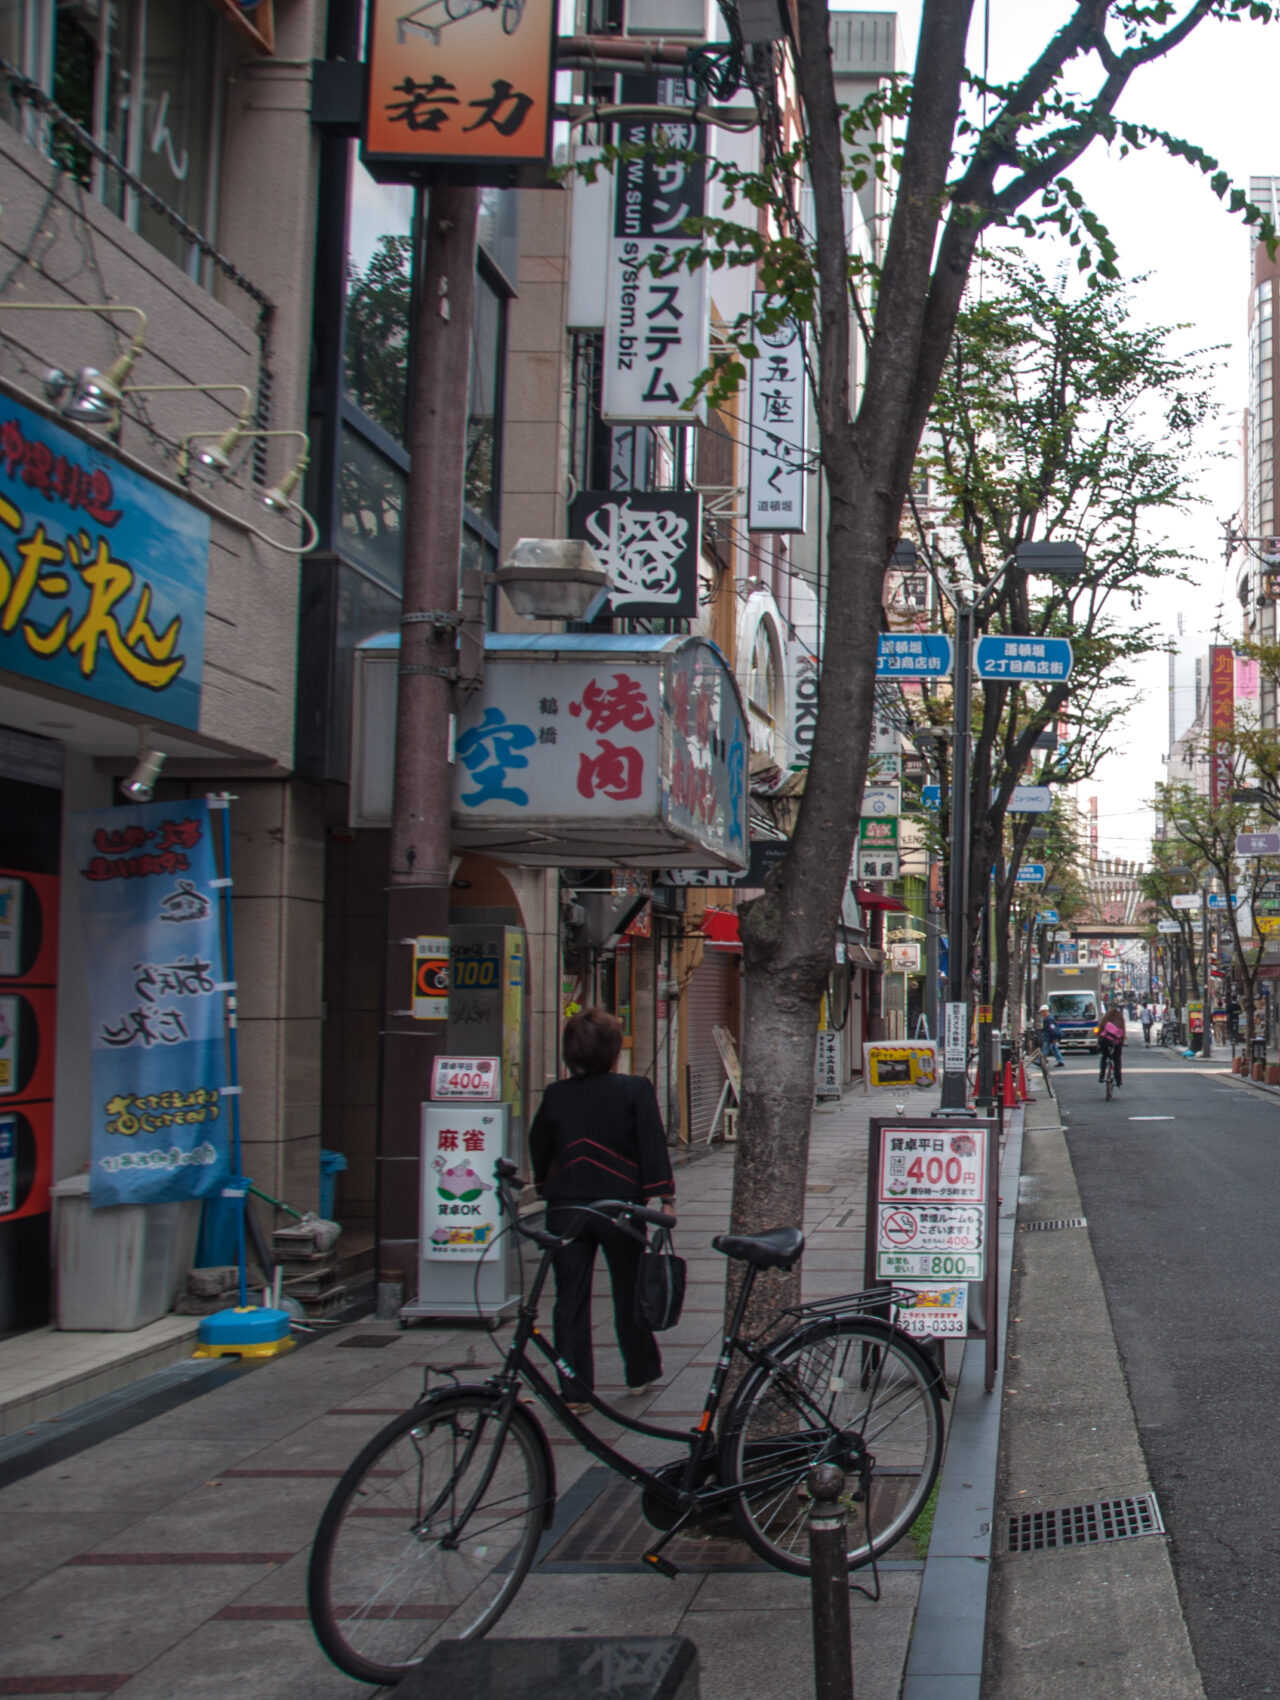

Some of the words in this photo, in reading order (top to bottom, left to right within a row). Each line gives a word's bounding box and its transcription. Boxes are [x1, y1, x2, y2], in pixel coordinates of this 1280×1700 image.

[385, 75, 534, 136] 若力
[617, 242, 640, 371] system.biz
[881, 640, 923, 654] 道頓堀
[1004, 643, 1046, 657] 道頓堀
[984, 659, 1064, 675] 2丁目商店街
[456, 706, 537, 808] 空
[456, 962, 495, 985] 100
[437, 1128, 486, 1152] 麻雀
[890, 1137, 944, 1152] 貸卓平日
[437, 1203, 482, 1216] 貸卓OK
